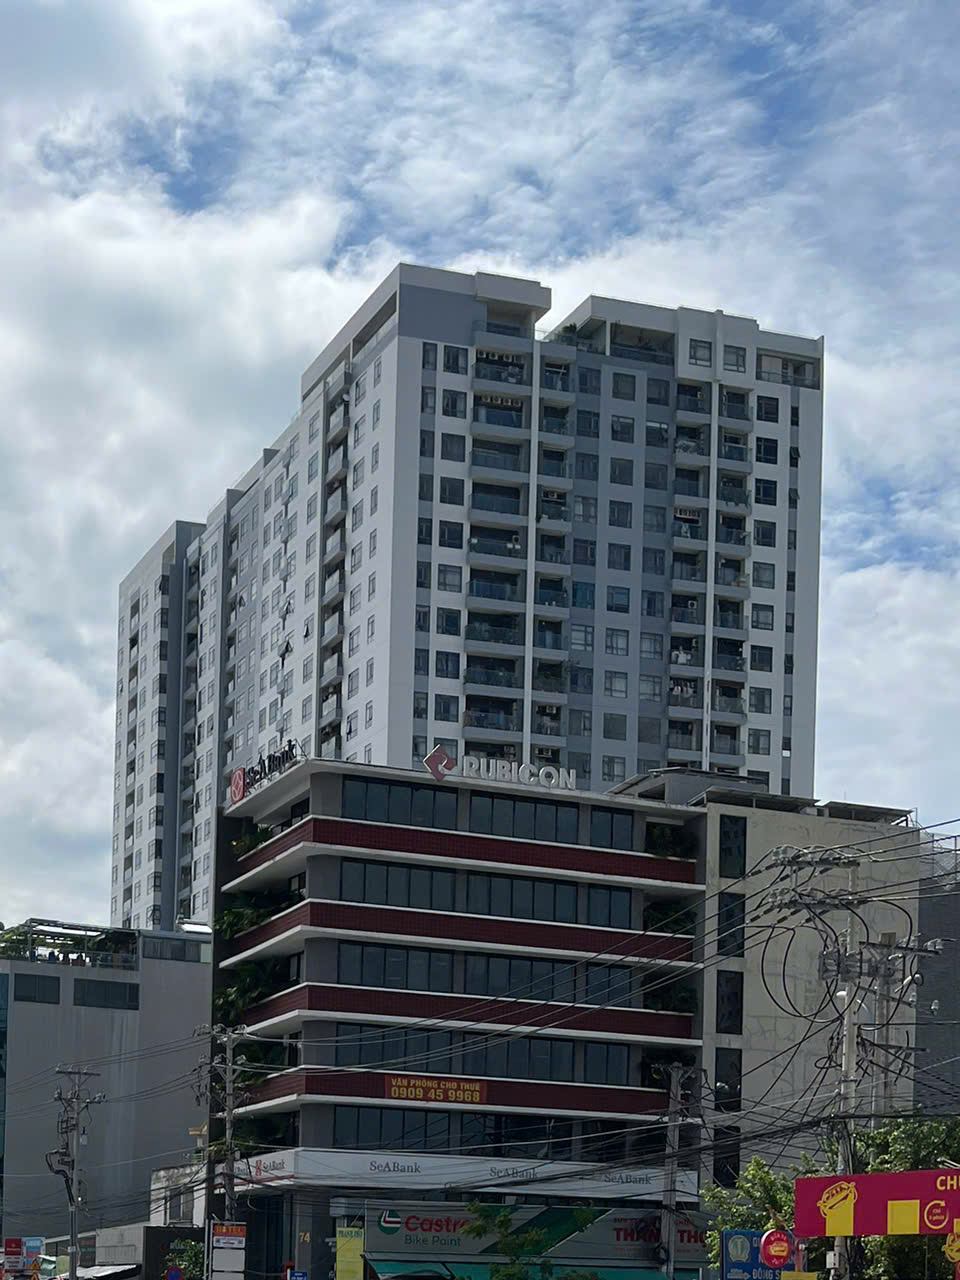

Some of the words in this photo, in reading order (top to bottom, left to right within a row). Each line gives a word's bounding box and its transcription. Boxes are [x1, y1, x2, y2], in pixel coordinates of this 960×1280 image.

[463, 755, 577, 790] RUBICON
[440, 1081, 457, 1090] CHO
[391, 1087, 423, 1099] 0909
[427, 1088, 444, 1100] 45
[448, 1090, 480, 1103] 9968
[369, 1160, 421, 1174] SeABank
[490, 1166, 539, 1180] SeABank
[604, 1173, 652, 1185] SeABank
[936, 1175, 960, 1191] CH
[299, 1231, 311, 1243] 74
[404, 1234, 429, 1246] Bike
